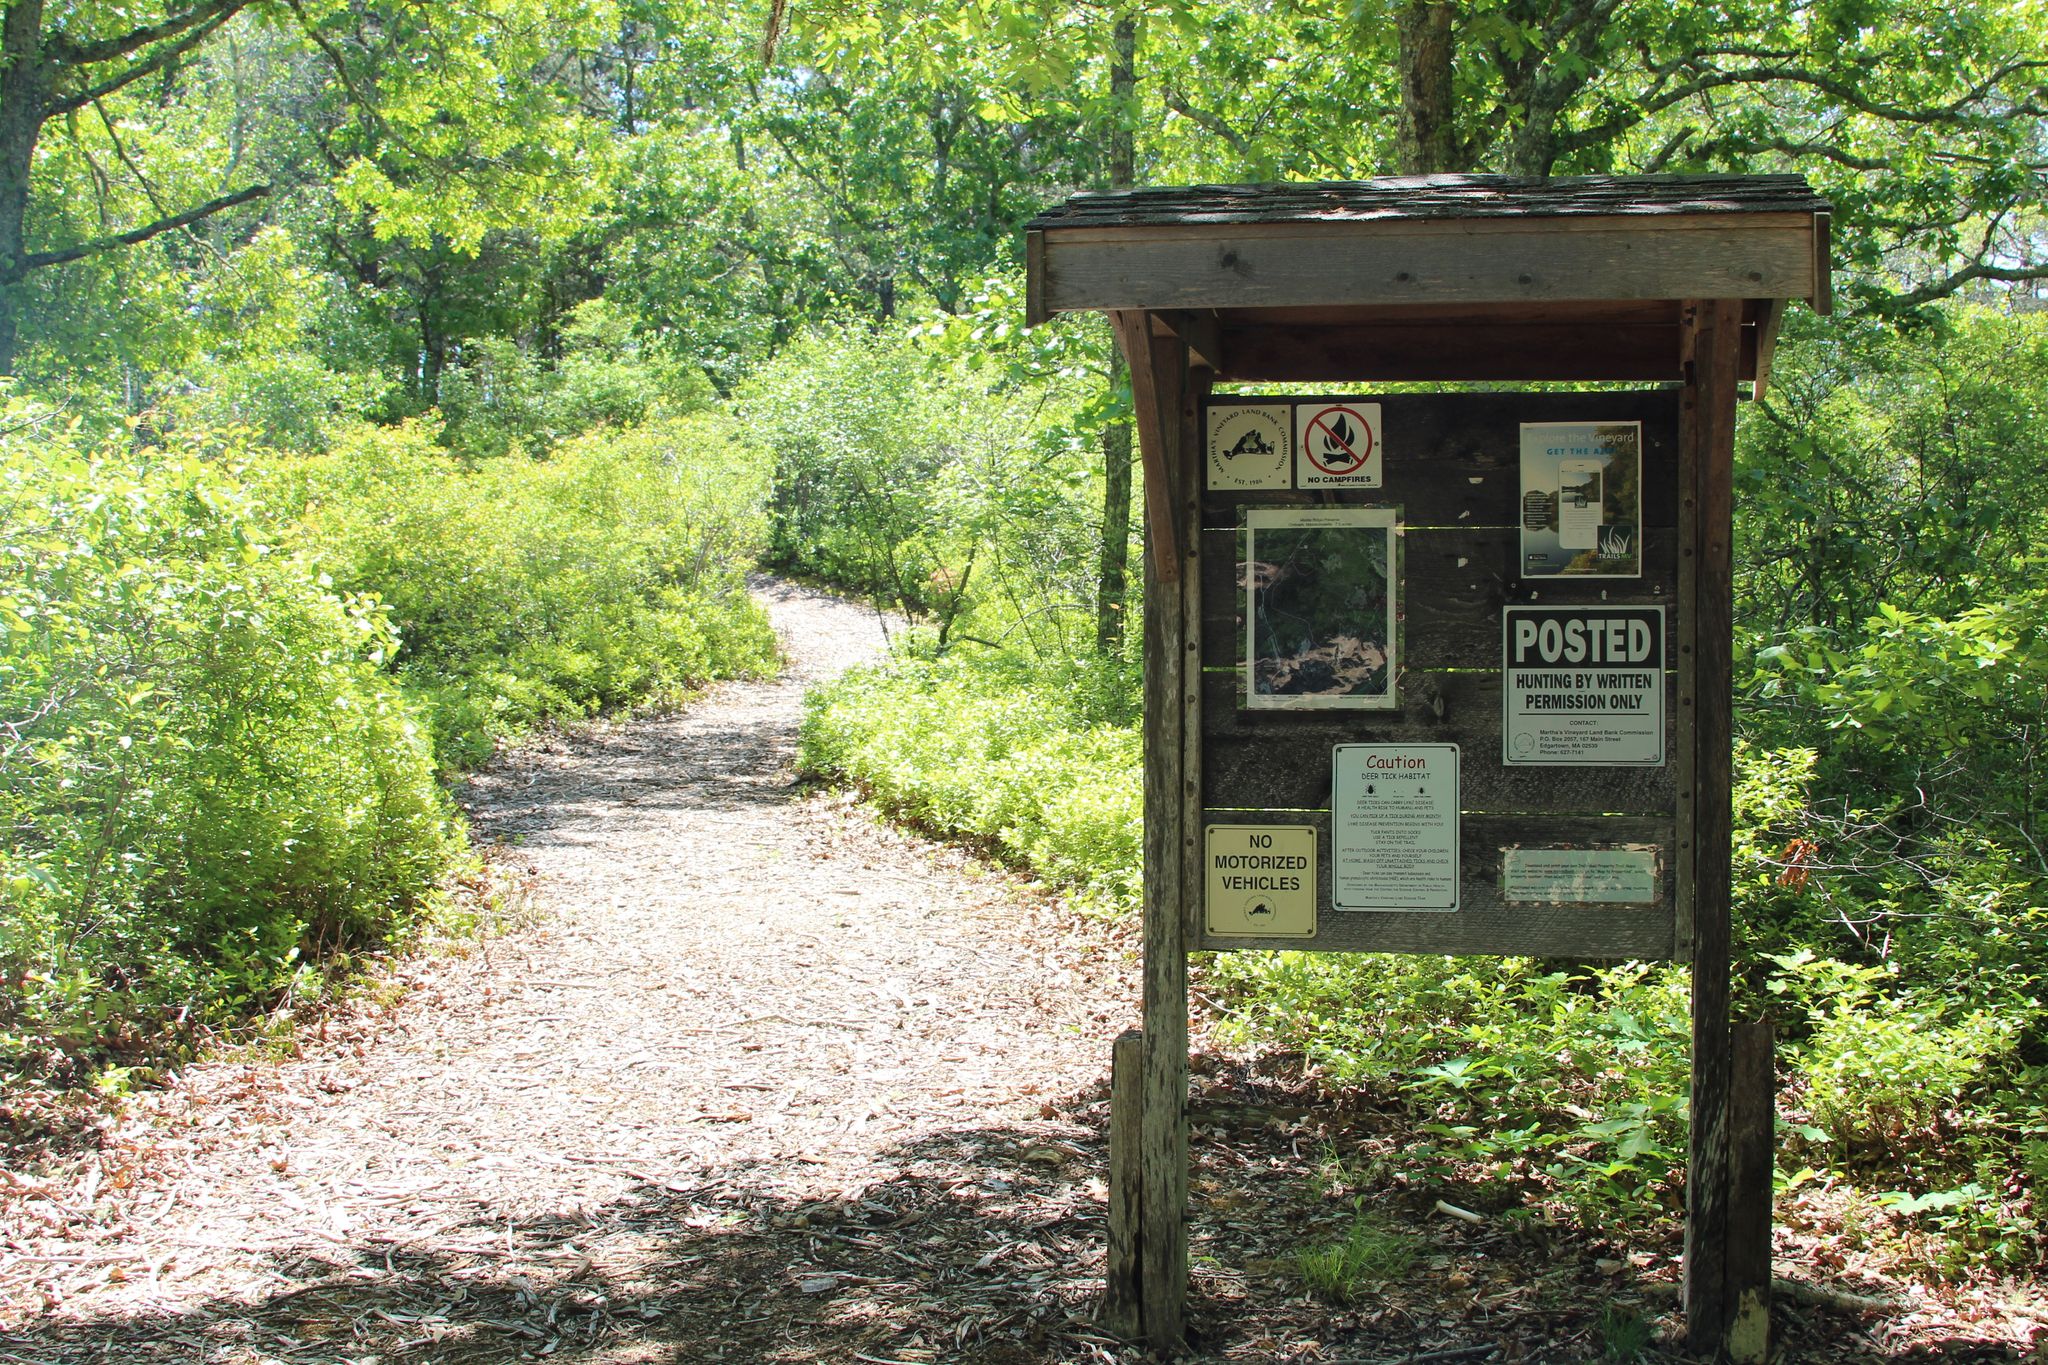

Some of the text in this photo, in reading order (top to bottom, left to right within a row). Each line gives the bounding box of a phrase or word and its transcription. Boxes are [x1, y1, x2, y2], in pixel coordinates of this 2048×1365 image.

[1214, 411, 1239, 437] VINEYARD
[1262, 411, 1278, 426] BANK
[1275, 426, 1288, 471] COMMISSION
[1589, 432, 1634, 445] Vineyard
[1515, 619, 1652, 663] POSTED
[1516, 673, 1652, 689] HUNTING BY WRITTEN
[1525, 694, 1643, 709] PERMISSION ONLY
[1366, 755, 1426, 769] Caution
[1249, 834, 1273, 848] NO
[1215, 855, 1308, 870] MOTORIZED
[1222, 876, 1300, 891] VEHICLES
